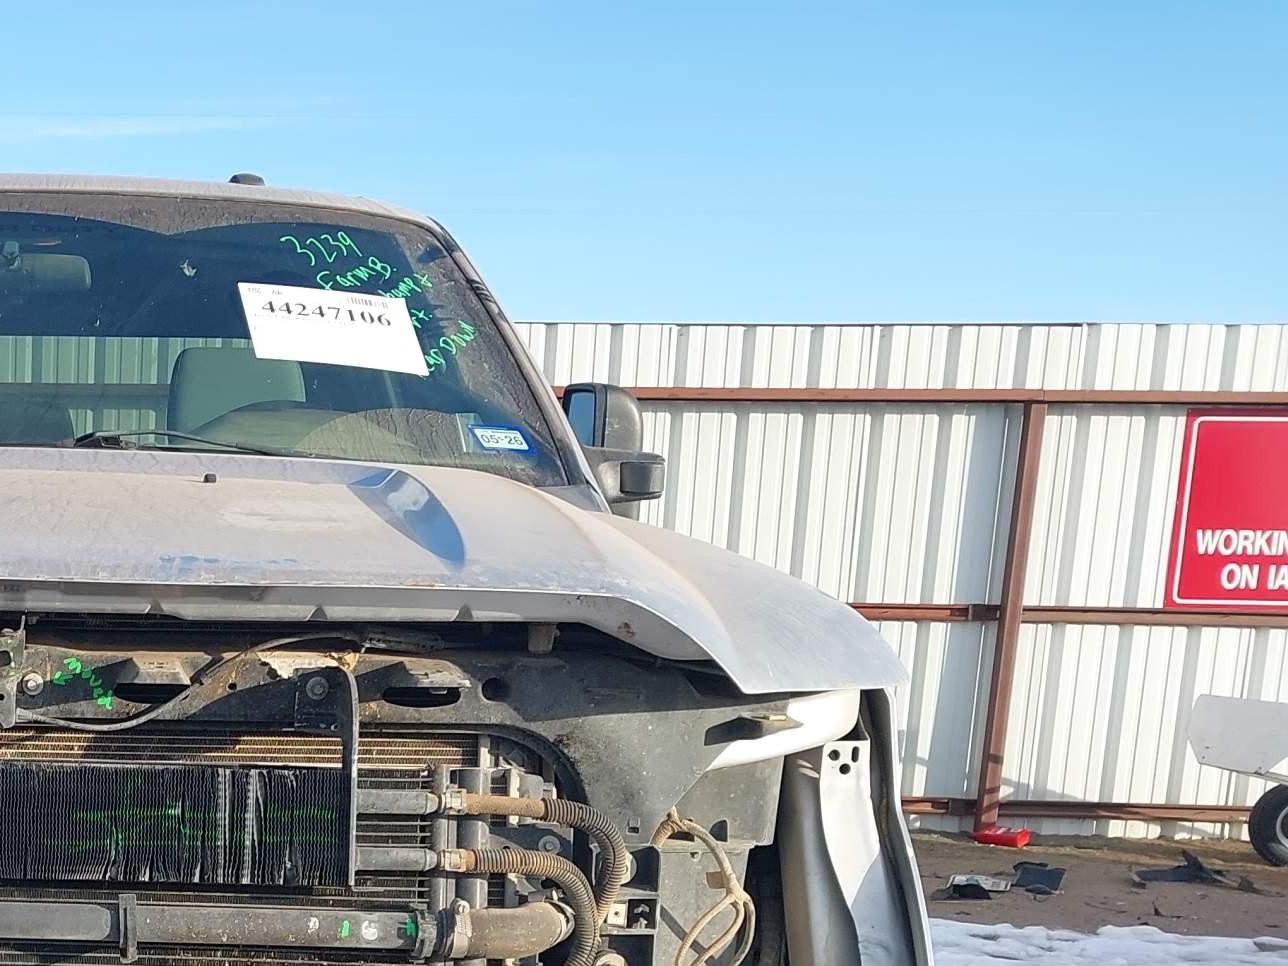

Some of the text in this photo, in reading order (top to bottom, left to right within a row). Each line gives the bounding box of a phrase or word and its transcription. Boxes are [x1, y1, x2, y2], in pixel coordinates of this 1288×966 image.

[279, 231, 363, 266] 3239
[261, 300, 392, 327] 44247106
[1219, 562, 1259, 591] ON
